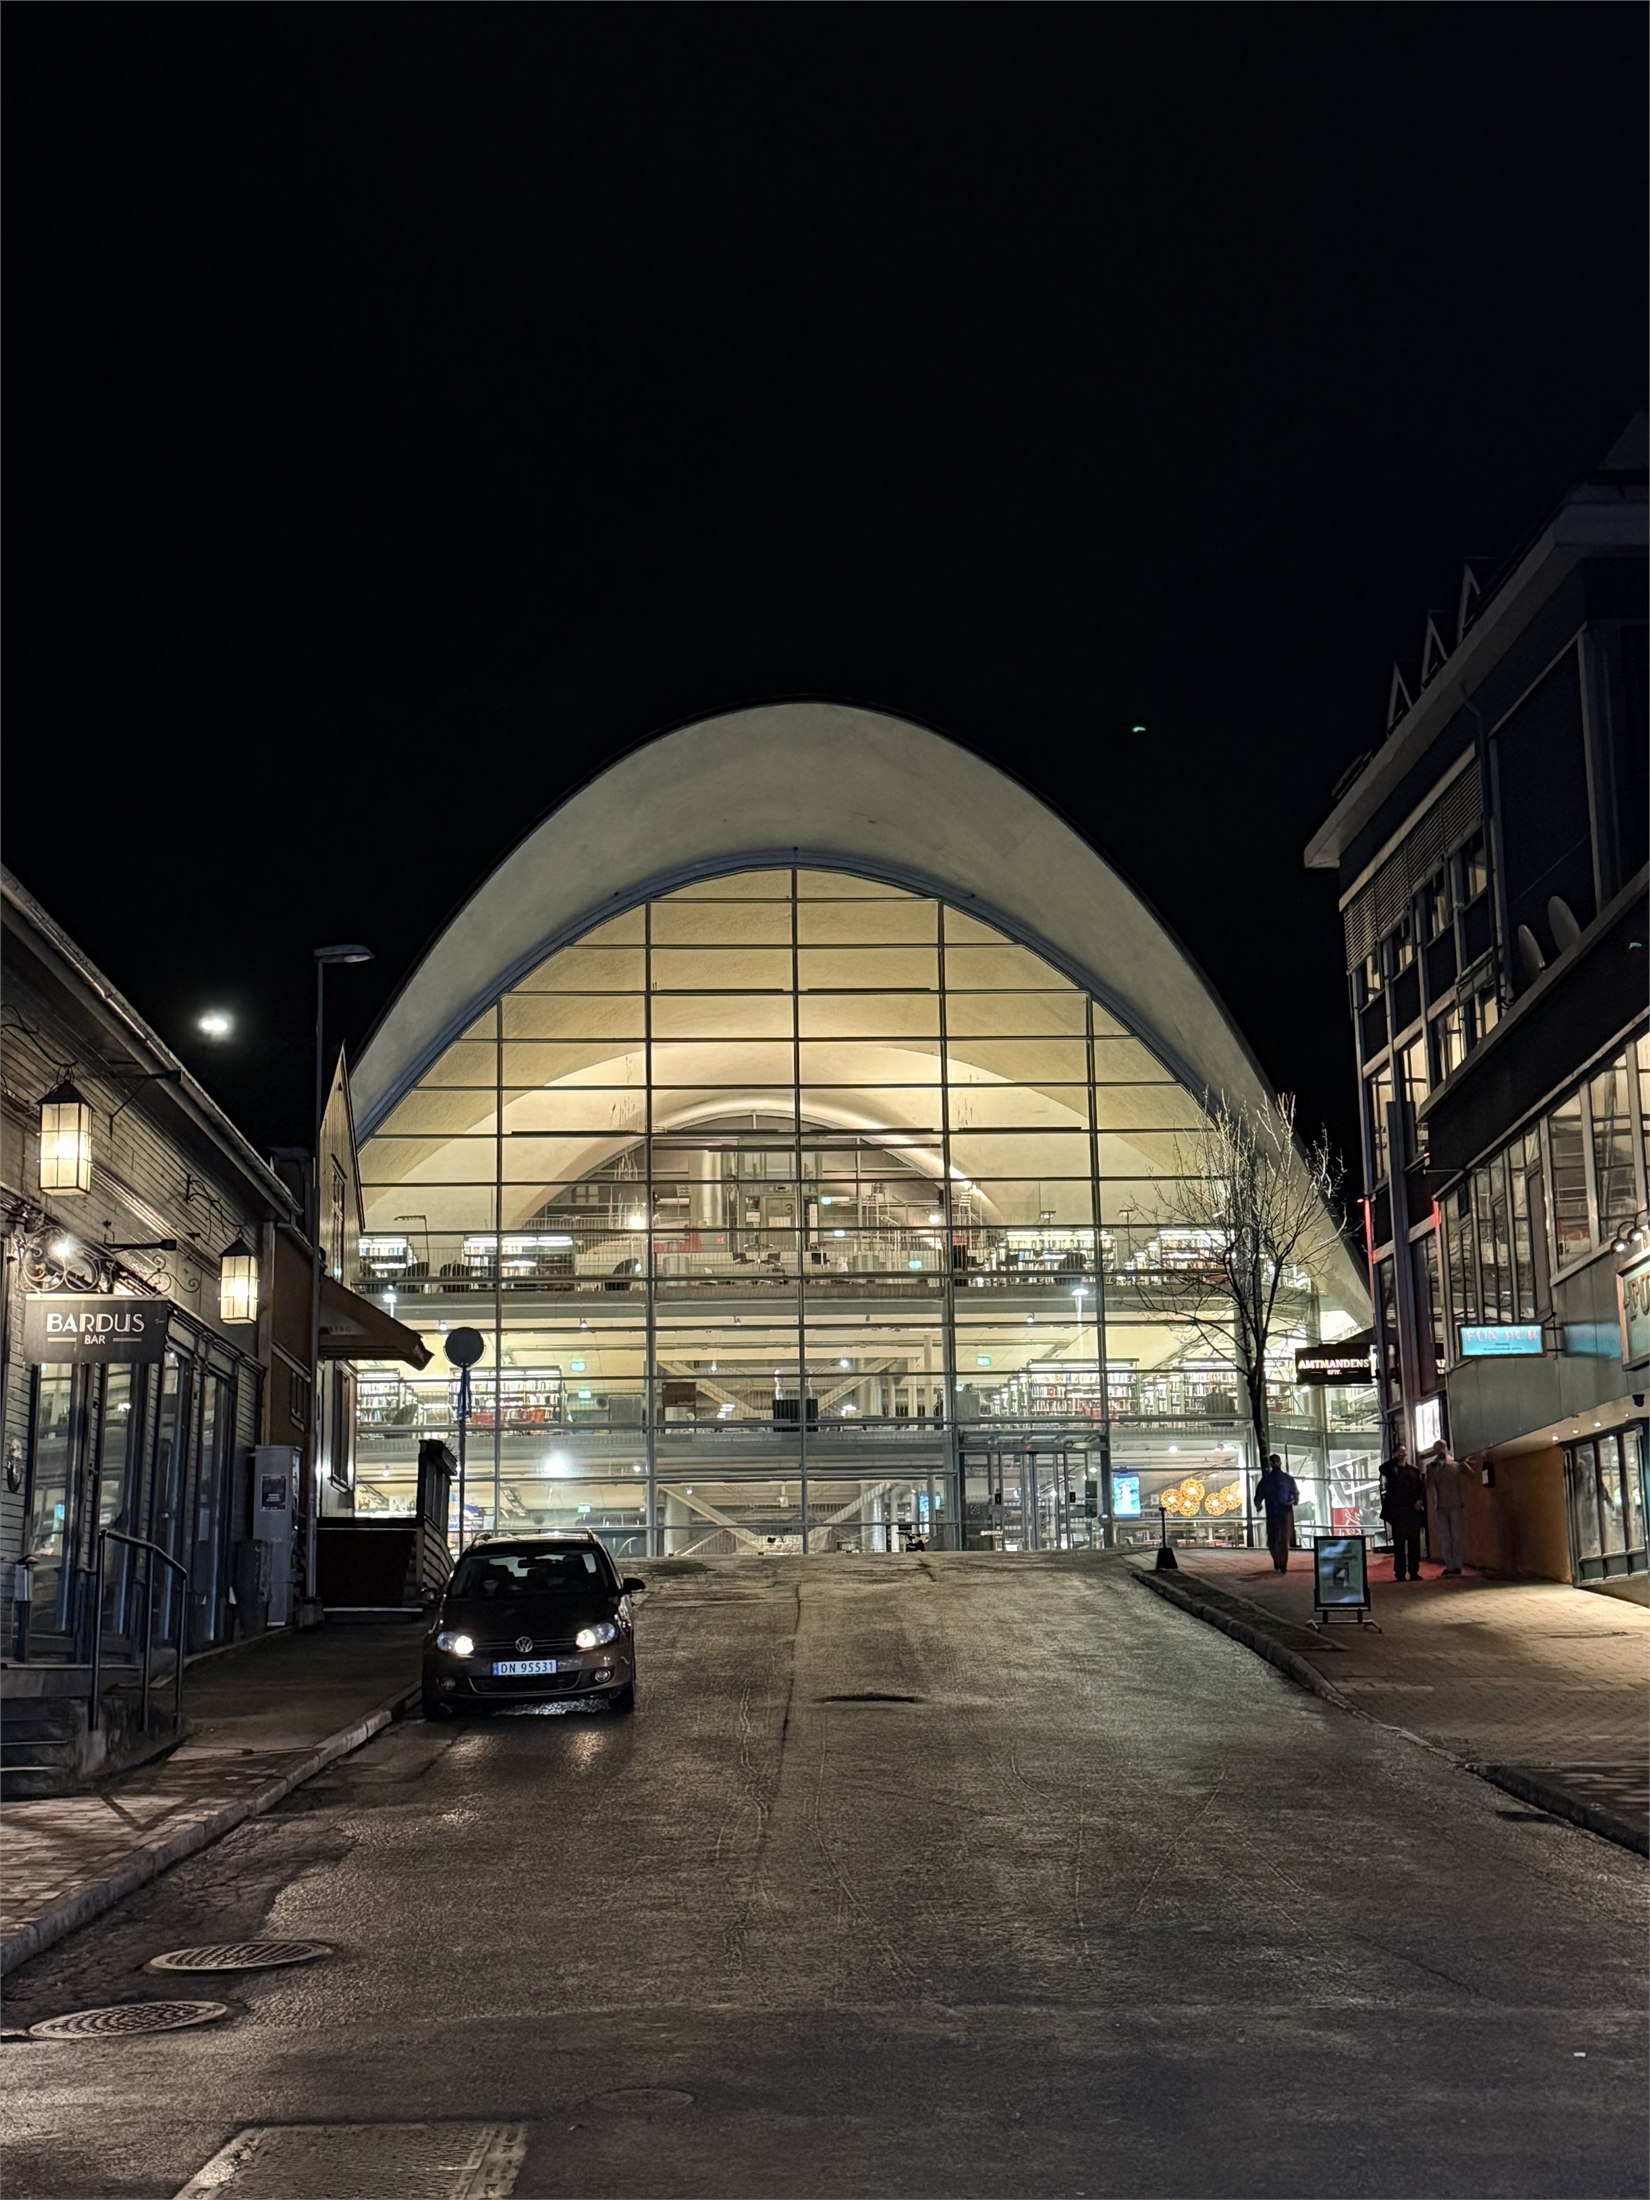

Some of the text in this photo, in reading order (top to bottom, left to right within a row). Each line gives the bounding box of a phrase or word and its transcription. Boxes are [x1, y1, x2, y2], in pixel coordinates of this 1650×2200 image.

[46, 1313, 145, 1333] BARDUS
[84, 1335, 106, 1345] BAR
[1298, 1359, 1370, 1370] AMTMANDENS
[501, 1661, 553, 1674] DN 95531
